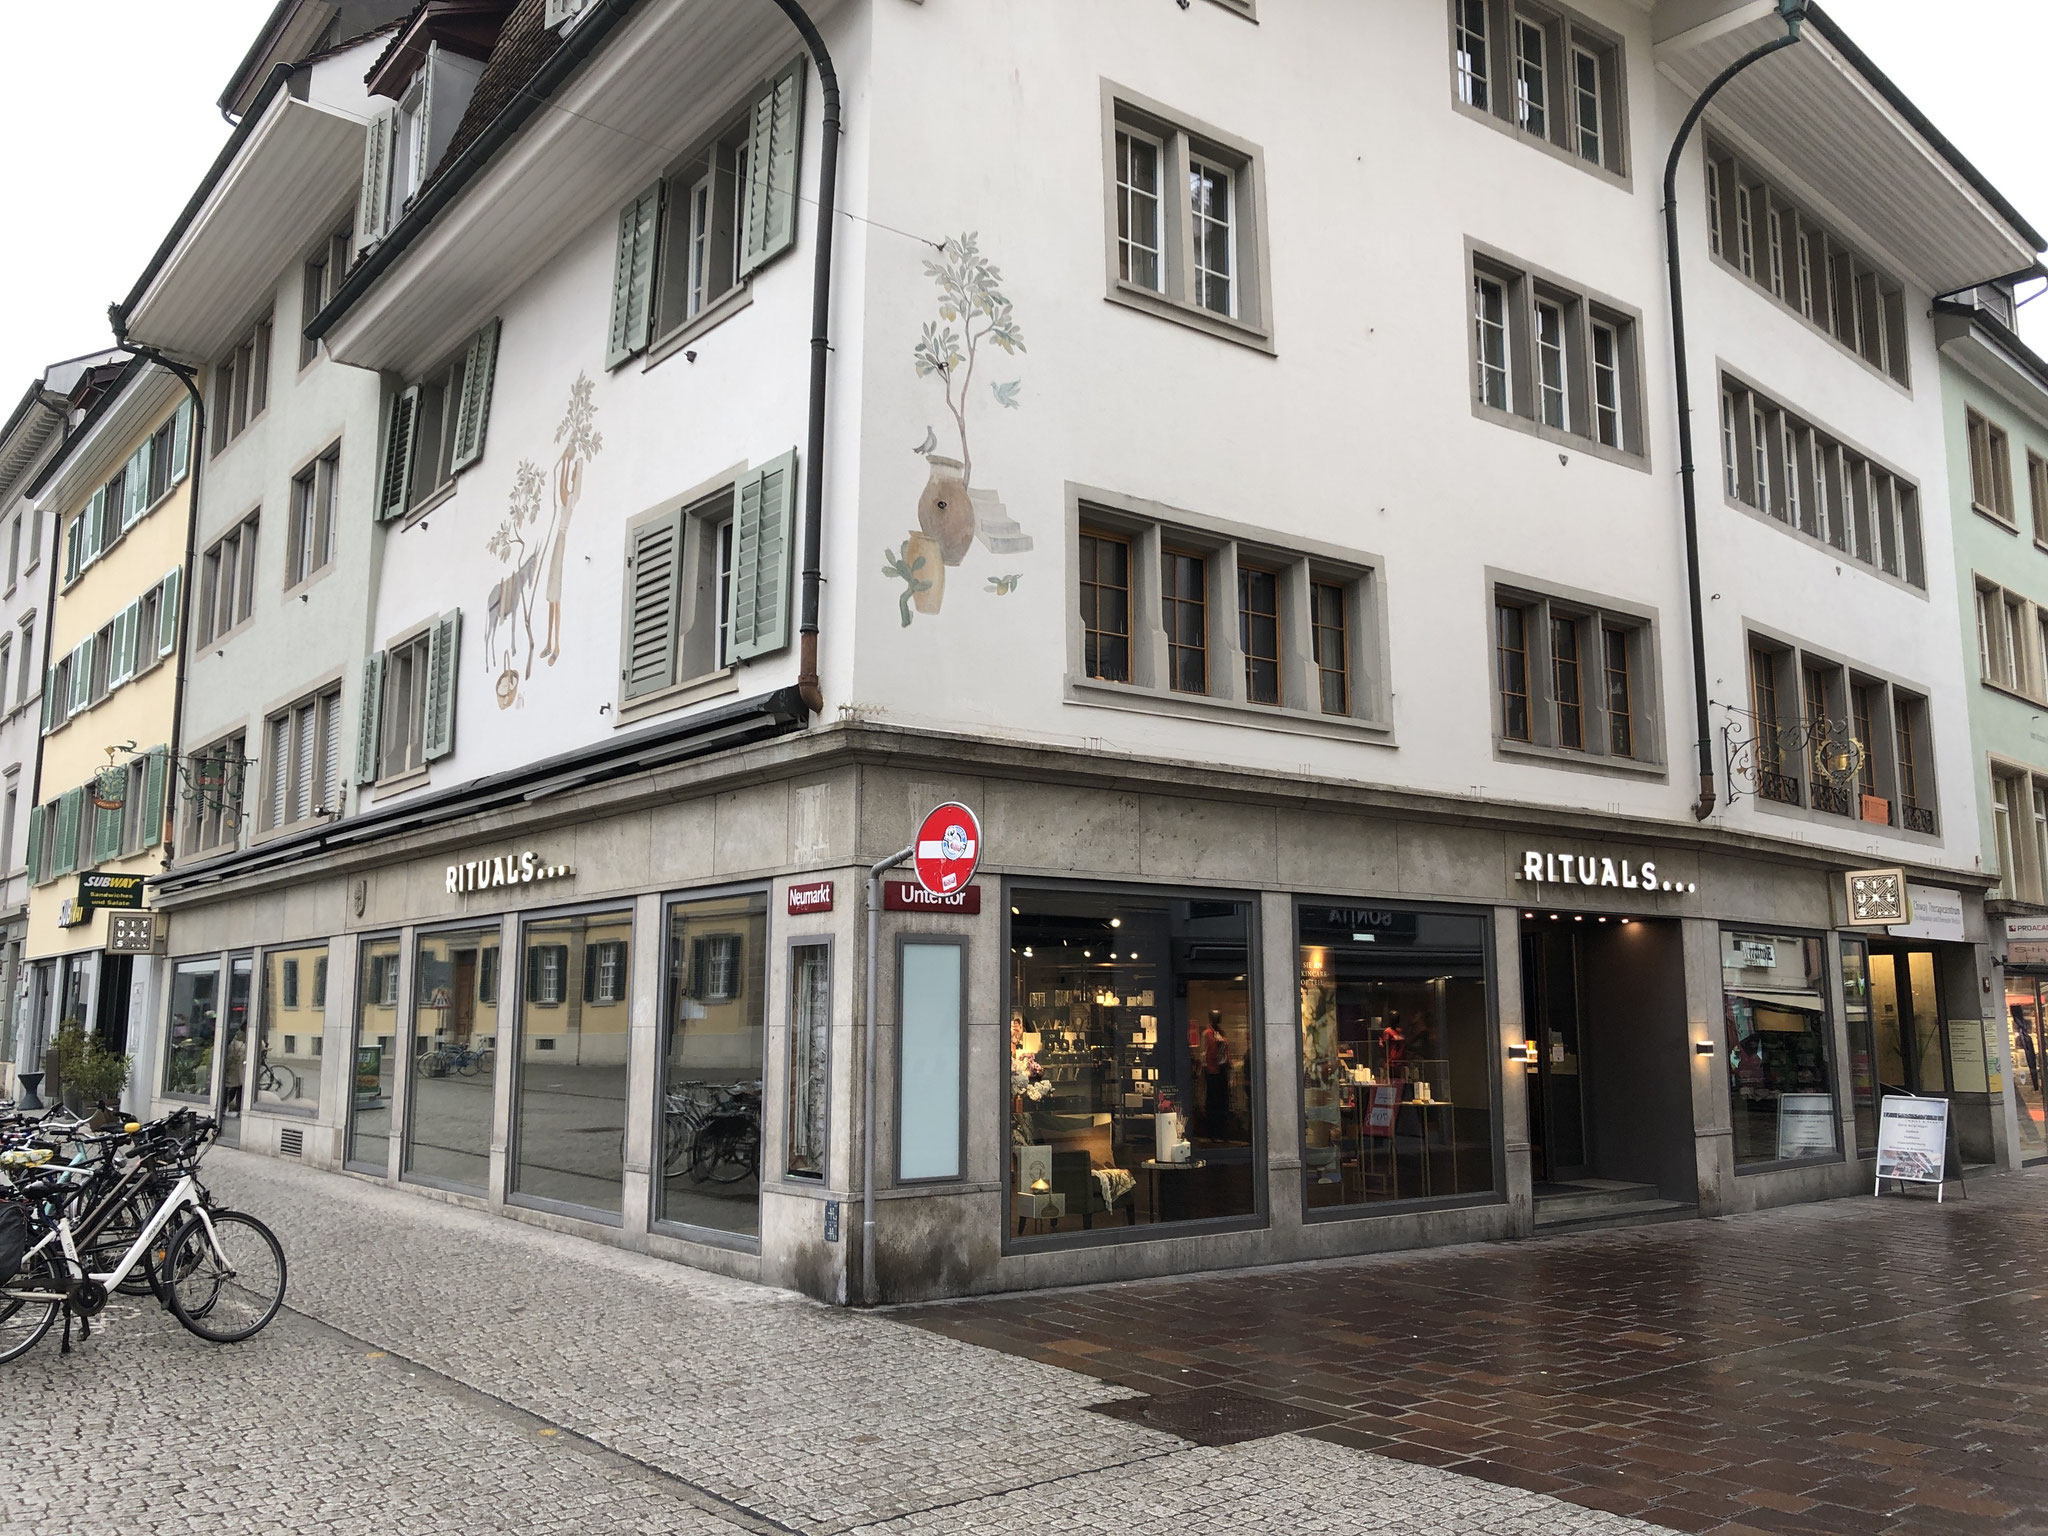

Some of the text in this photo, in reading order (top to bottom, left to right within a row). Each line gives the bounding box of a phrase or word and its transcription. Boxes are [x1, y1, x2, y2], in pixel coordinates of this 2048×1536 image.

[83, 876, 141, 889] SUBWAY
[445, 851, 567, 893] RITUALS...
[1523, 851, 1696, 893] RITUALS...
[89, 891, 134, 899] Sandwiches
[789, 884, 830, 906] Neumarkt
